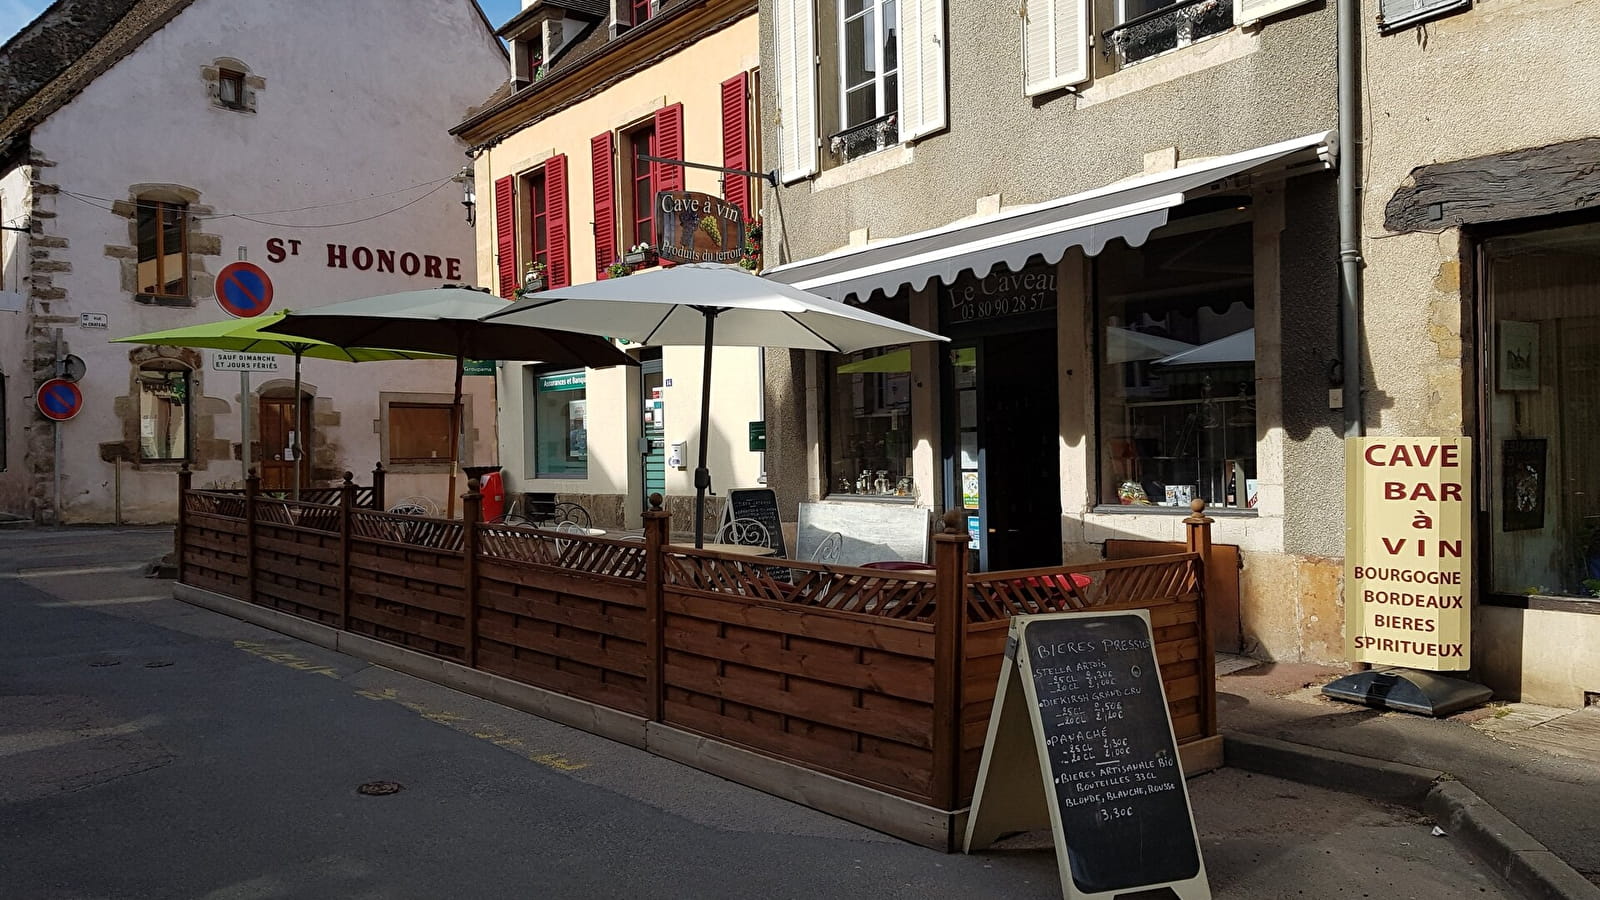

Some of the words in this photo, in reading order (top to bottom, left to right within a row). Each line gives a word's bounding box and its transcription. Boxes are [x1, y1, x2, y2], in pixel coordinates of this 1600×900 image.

[662, 194, 699, 213] Cave
[703, 196, 712, 214] à
[717, 202, 738, 222] vin
[662, 240, 700, 260] Produits
[702, 250, 713, 261] du
[716, 246, 742, 260] terroir
[326, 243, 461, 281] HONORE
[948, 286, 975, 309] Le
[962, 304, 974, 320] 03
[978, 301, 992, 318] 80
[994, 298, 1008, 315] 90
[1012, 296, 1026, 312] 28
[1030, 292, 1044, 310] 57
[544, 378, 566, 388] Assurances
[1364, 444, 1459, 468] CAVE
[1385, 482, 1462, 501] BAR
[1412, 510, 1432, 529] à
[1382, 537, 1462, 558] VIN
[1354, 567, 1461, 585] BOURGOGNE
[1364, 590, 1463, 609] BORDEAUX
[1375, 614, 1435, 632] BIERES
[1038, 641, 1095, 659] BIERES
[1354, 636, 1463, 657] SPIRITUEUX
[1036, 665, 1072, 678] STELLA
[1076, 659, 1106, 672] ARTOIS
[1092, 690, 1122, 700] GRAND
[1124, 688, 1141, 696] CRU
[1051, 726, 1107, 747] PANACHÉ
[1061, 771, 1096, 784] BIERES
[1100, 760, 1155, 777] ARTISANALE
[1076, 776, 1130, 792] BOUTEILLES
